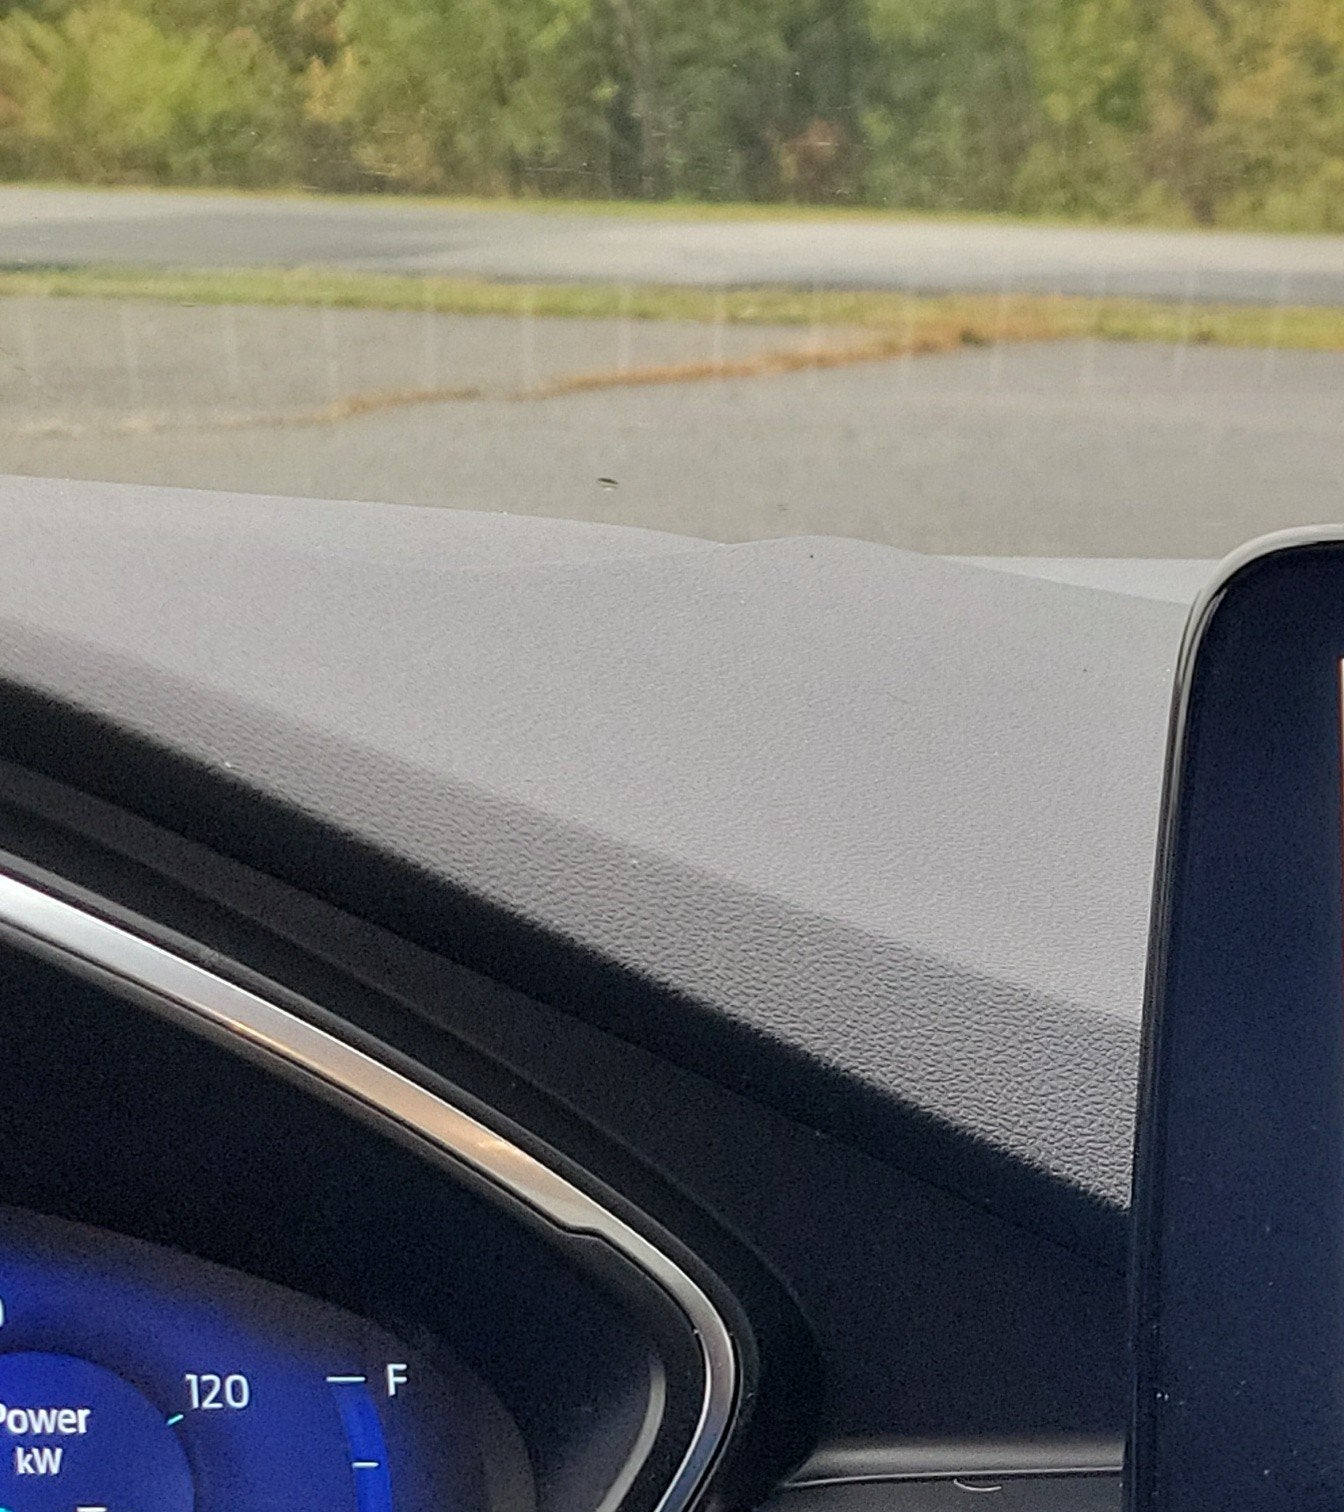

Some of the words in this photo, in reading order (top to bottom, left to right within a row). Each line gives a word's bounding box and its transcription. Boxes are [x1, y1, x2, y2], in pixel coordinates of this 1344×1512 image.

[185, 1372, 250, 1410] 120
[385, 1362, 408, 1396] F
[16, 1446, 63, 1475] kW
